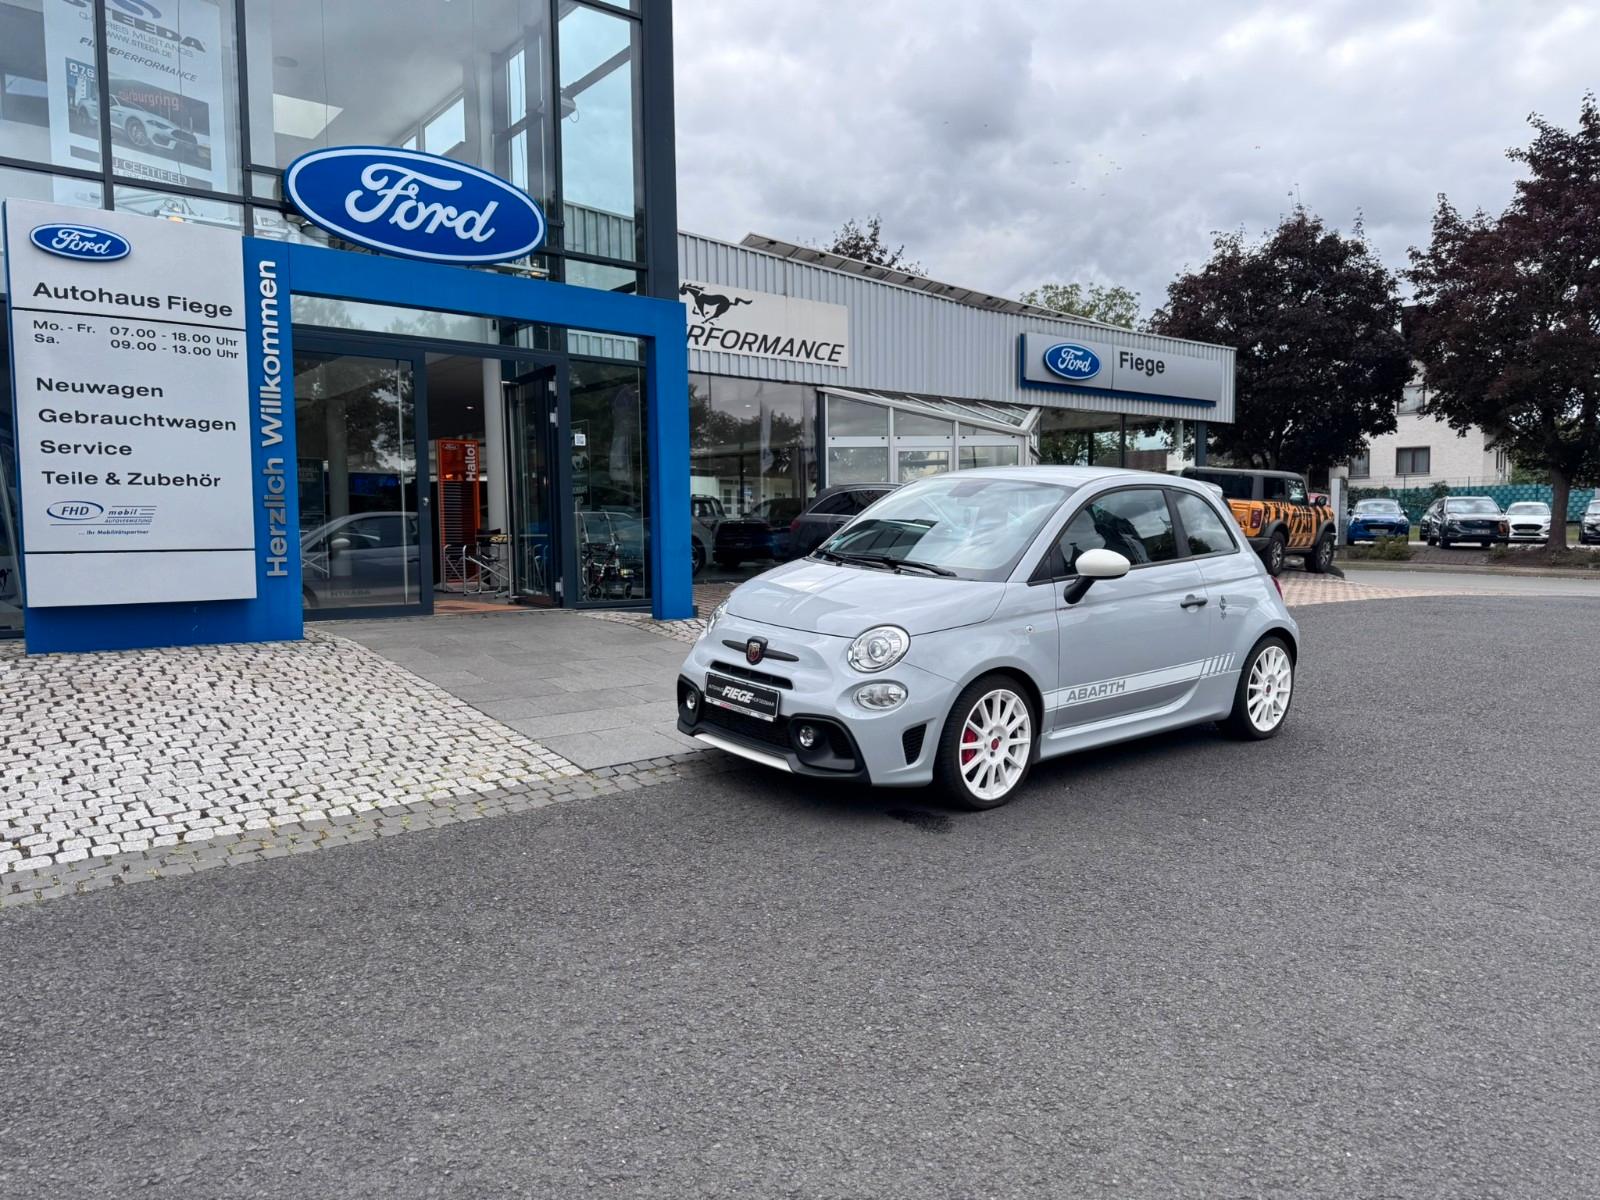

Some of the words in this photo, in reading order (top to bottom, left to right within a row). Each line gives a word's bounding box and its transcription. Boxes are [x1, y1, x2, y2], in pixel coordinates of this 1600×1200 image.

[79, 36, 199, 82] FIEPERFORMANCE
[345, 163, 499, 243] Ford
[52, 229, 112, 255] Ford
[33, 282, 160, 309] Autohaus
[167, 296, 233, 318] Fiege
[33, 320, 64, 332] Mo.
[77, 323, 96, 334] Fr.
[110, 326, 156, 339] 07.00
[171, 332, 211, 344] 18.00
[216, 336, 239, 347] Uhr
[34, 333, 60, 345] Sa.
[110, 339, 156, 352] 09.00
[172, 345, 211, 357] 13.00
[216, 348, 239, 360] Uhr
[687, 324, 845, 362] RFORMANCE
[258, 259, 283, 448] Willkommen
[1057, 348, 1092, 373] Ford
[1119, 351, 1165, 376] Fiege
[36, 377, 164, 399] Neuwagen
[38, 408, 237, 433] Gebrauchtwagen
[40, 439, 133, 456] Service
[464, 444, 477, 482] Hallo!
[41, 471, 98, 485] Teile
[105, 472, 121, 486] &
[127, 472, 221, 487] Zubehör
[61, 506, 90, 516] FHD
[262, 457, 288, 577] Herzlich
[722, 685, 755, 704] FIEGE
[1066, 680, 1126, 702] ABARTH
